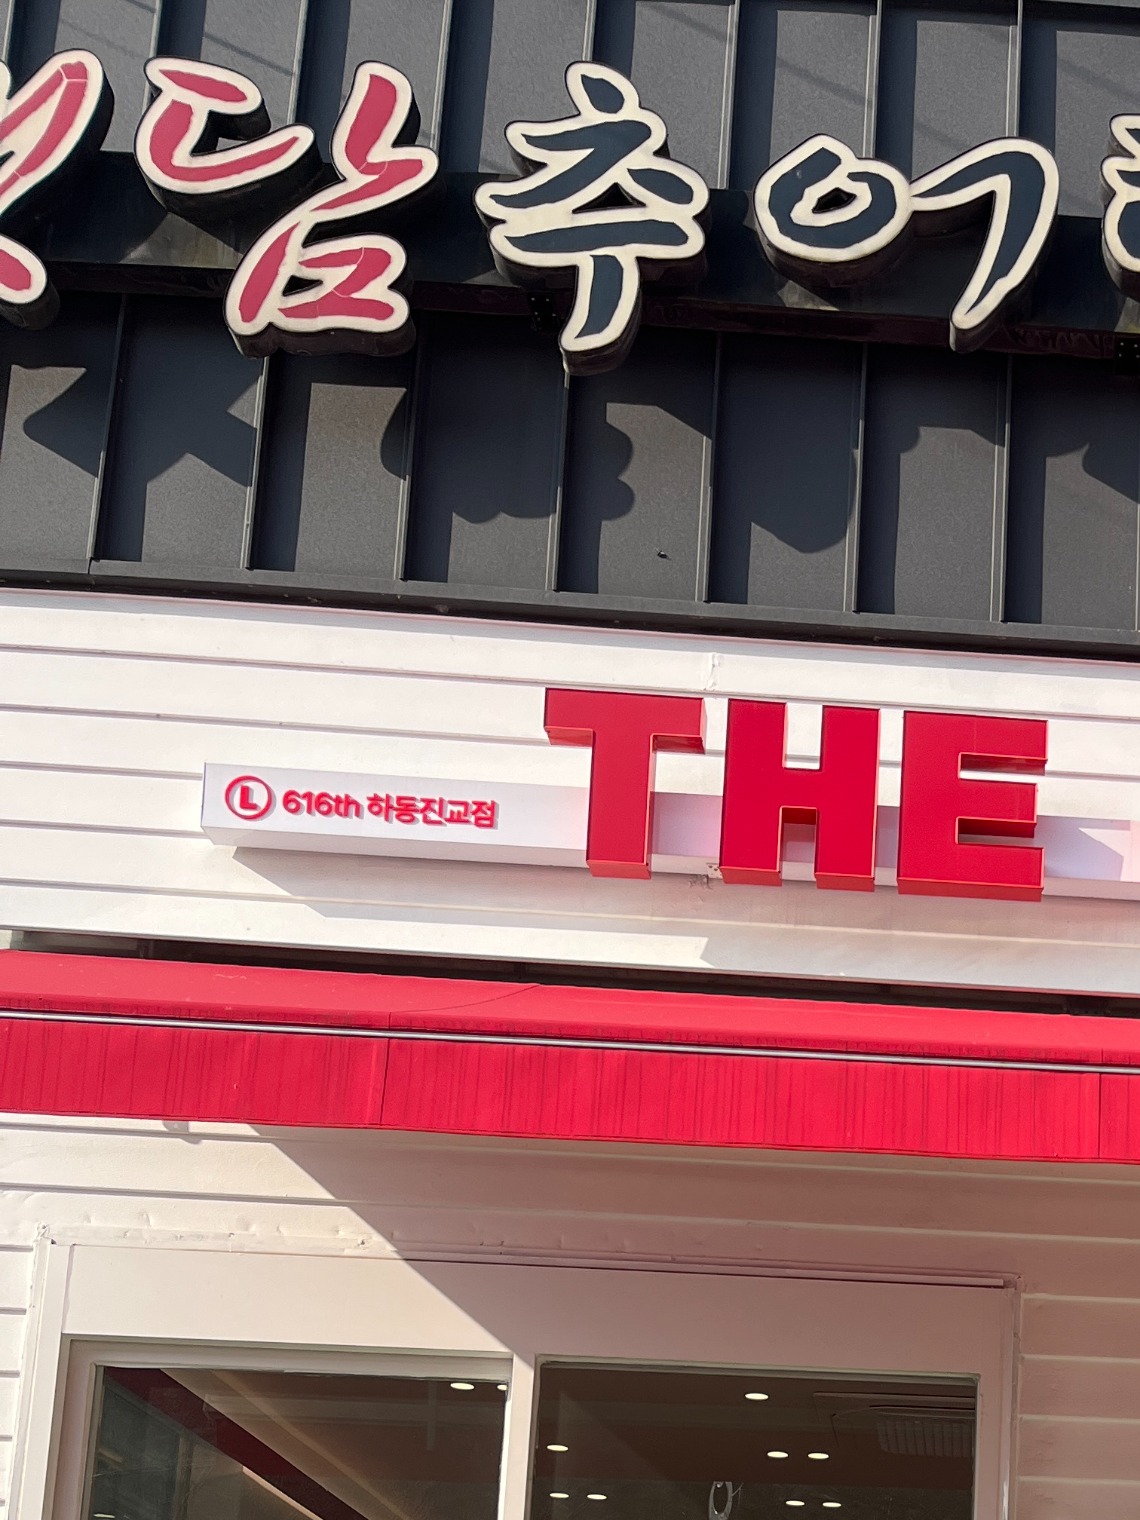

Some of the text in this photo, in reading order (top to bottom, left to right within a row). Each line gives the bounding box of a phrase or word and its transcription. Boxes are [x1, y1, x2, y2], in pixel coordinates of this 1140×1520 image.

[282, 789, 361, 818] 616th
[367, 793, 496, 829] 하동진교점
[544, 688, 1048, 898] THE
